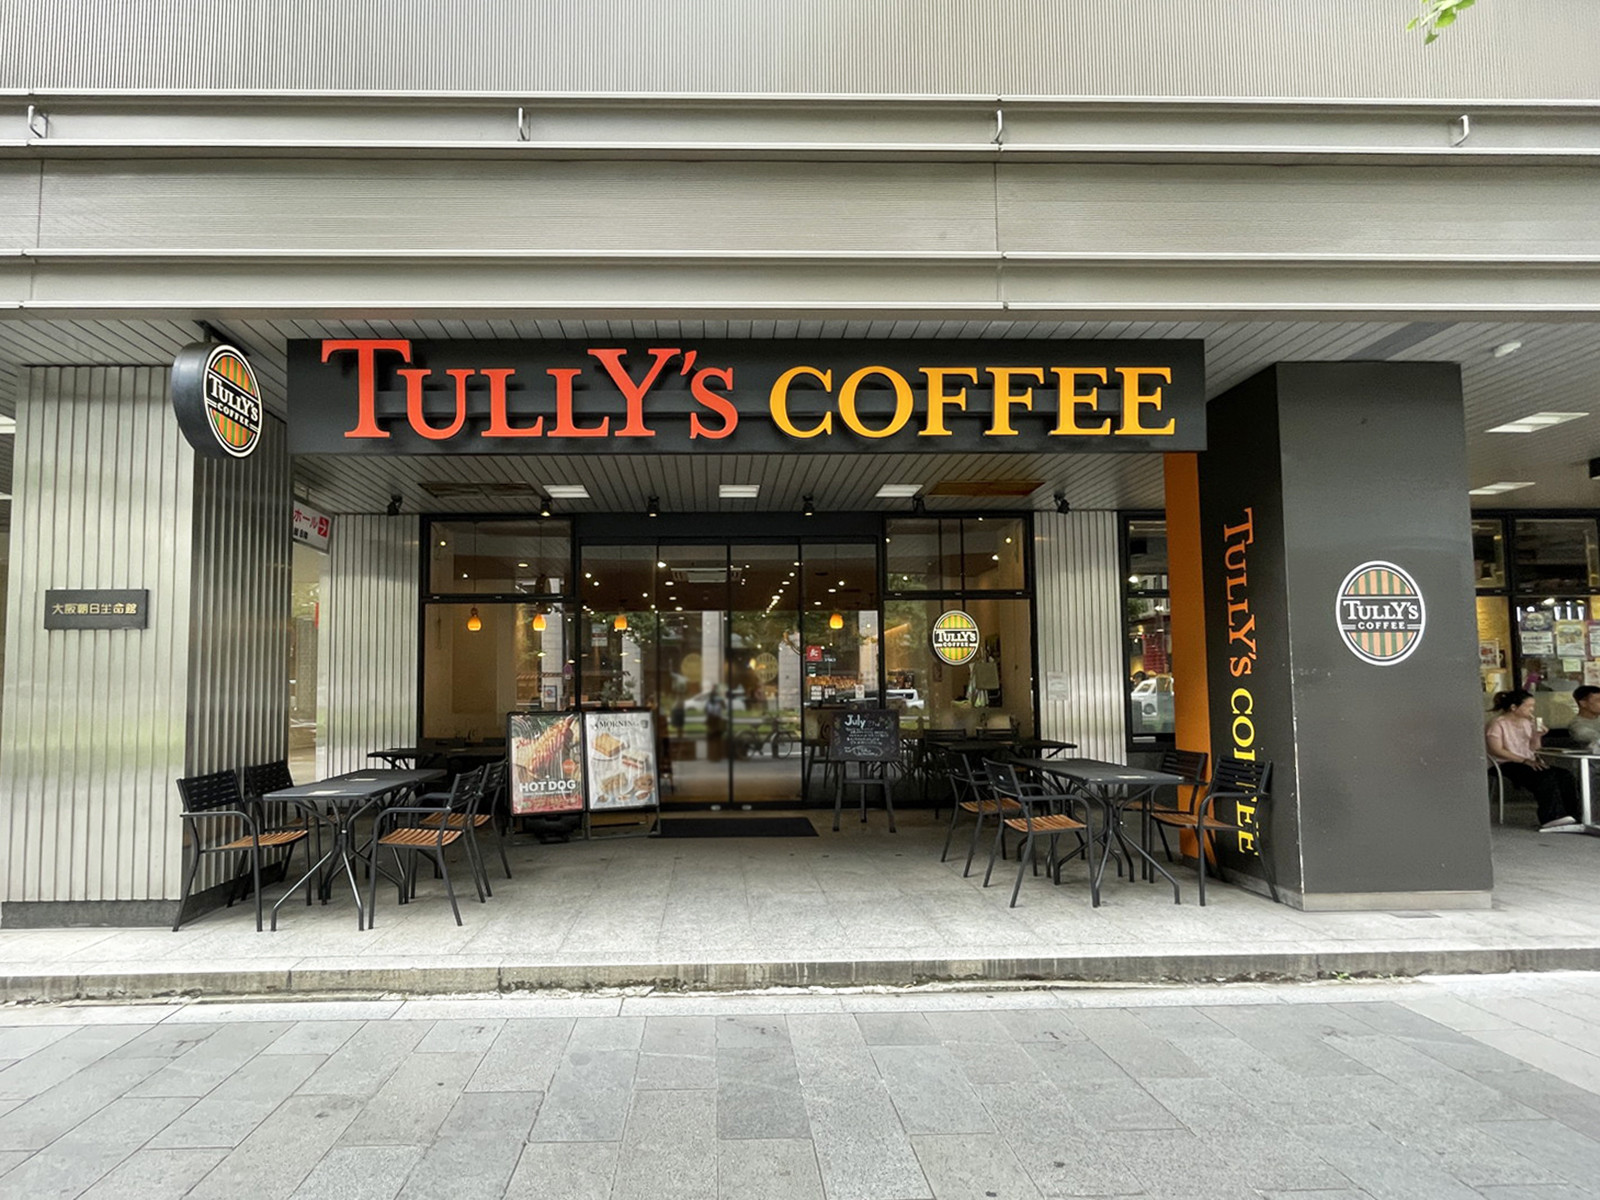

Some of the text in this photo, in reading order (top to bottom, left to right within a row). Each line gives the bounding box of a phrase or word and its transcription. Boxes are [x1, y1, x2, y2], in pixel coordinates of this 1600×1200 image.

[208, 373, 259, 422] TULLY'S
[321, 339, 1176, 440] TULLY'S COFFEE
[217, 402, 250, 428] COFFEE
[1343, 600, 1419, 620] TULLY'S
[1357, 621, 1406, 630] COFFEE
[936, 630, 976, 642] TULLY'S
[1223, 507, 1260, 857] TULLY'S COEE
[844, 714, 867, 730] July
[519, 779, 577, 793] HOT DOG
